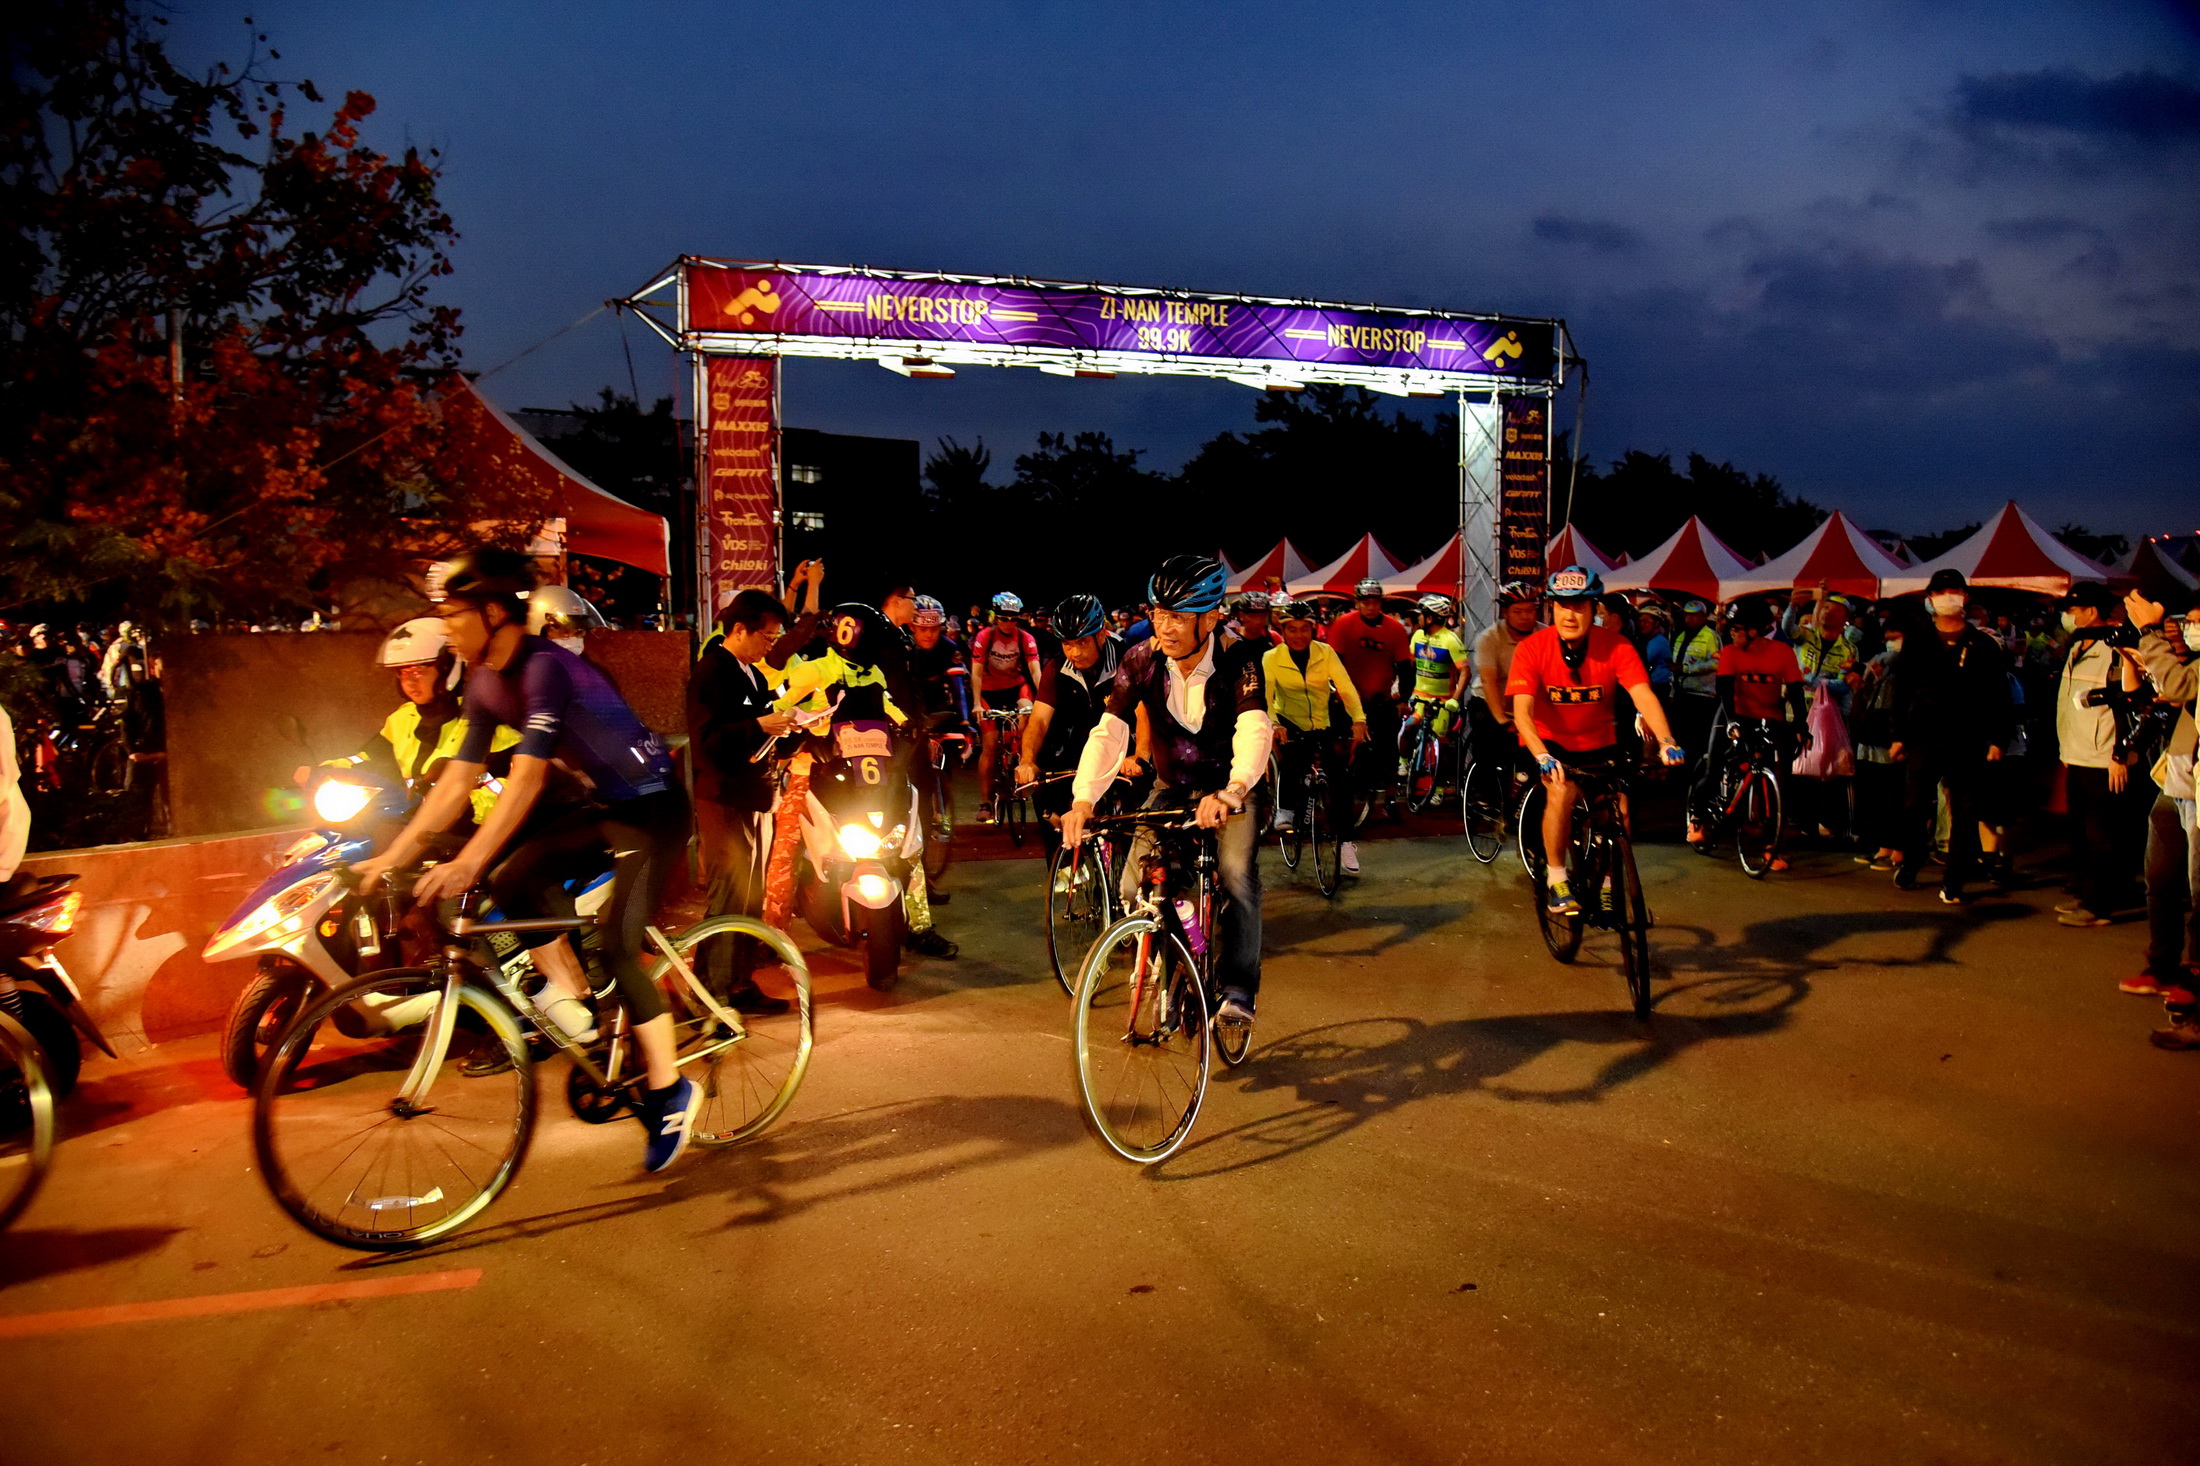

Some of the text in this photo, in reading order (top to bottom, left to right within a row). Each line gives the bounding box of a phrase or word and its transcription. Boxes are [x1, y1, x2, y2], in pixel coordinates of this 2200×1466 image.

[867, 294, 988, 325] NEVERSTOP
[1100, 297, 1228, 326] ZI-NAN TEMPLE
[1138, 327, 1192, 352] 99.9K
[1328, 324, 1426, 353] NEVERSTOP
[713, 421, 769, 432] MAXXIS
[1505, 451, 1543, 460] MAXXIS
[722, 540, 748, 550] VDS
[1509, 549, 1526, 558] VDS
[836, 616, 856, 645] 6
[861, 756, 880, 785] 6
